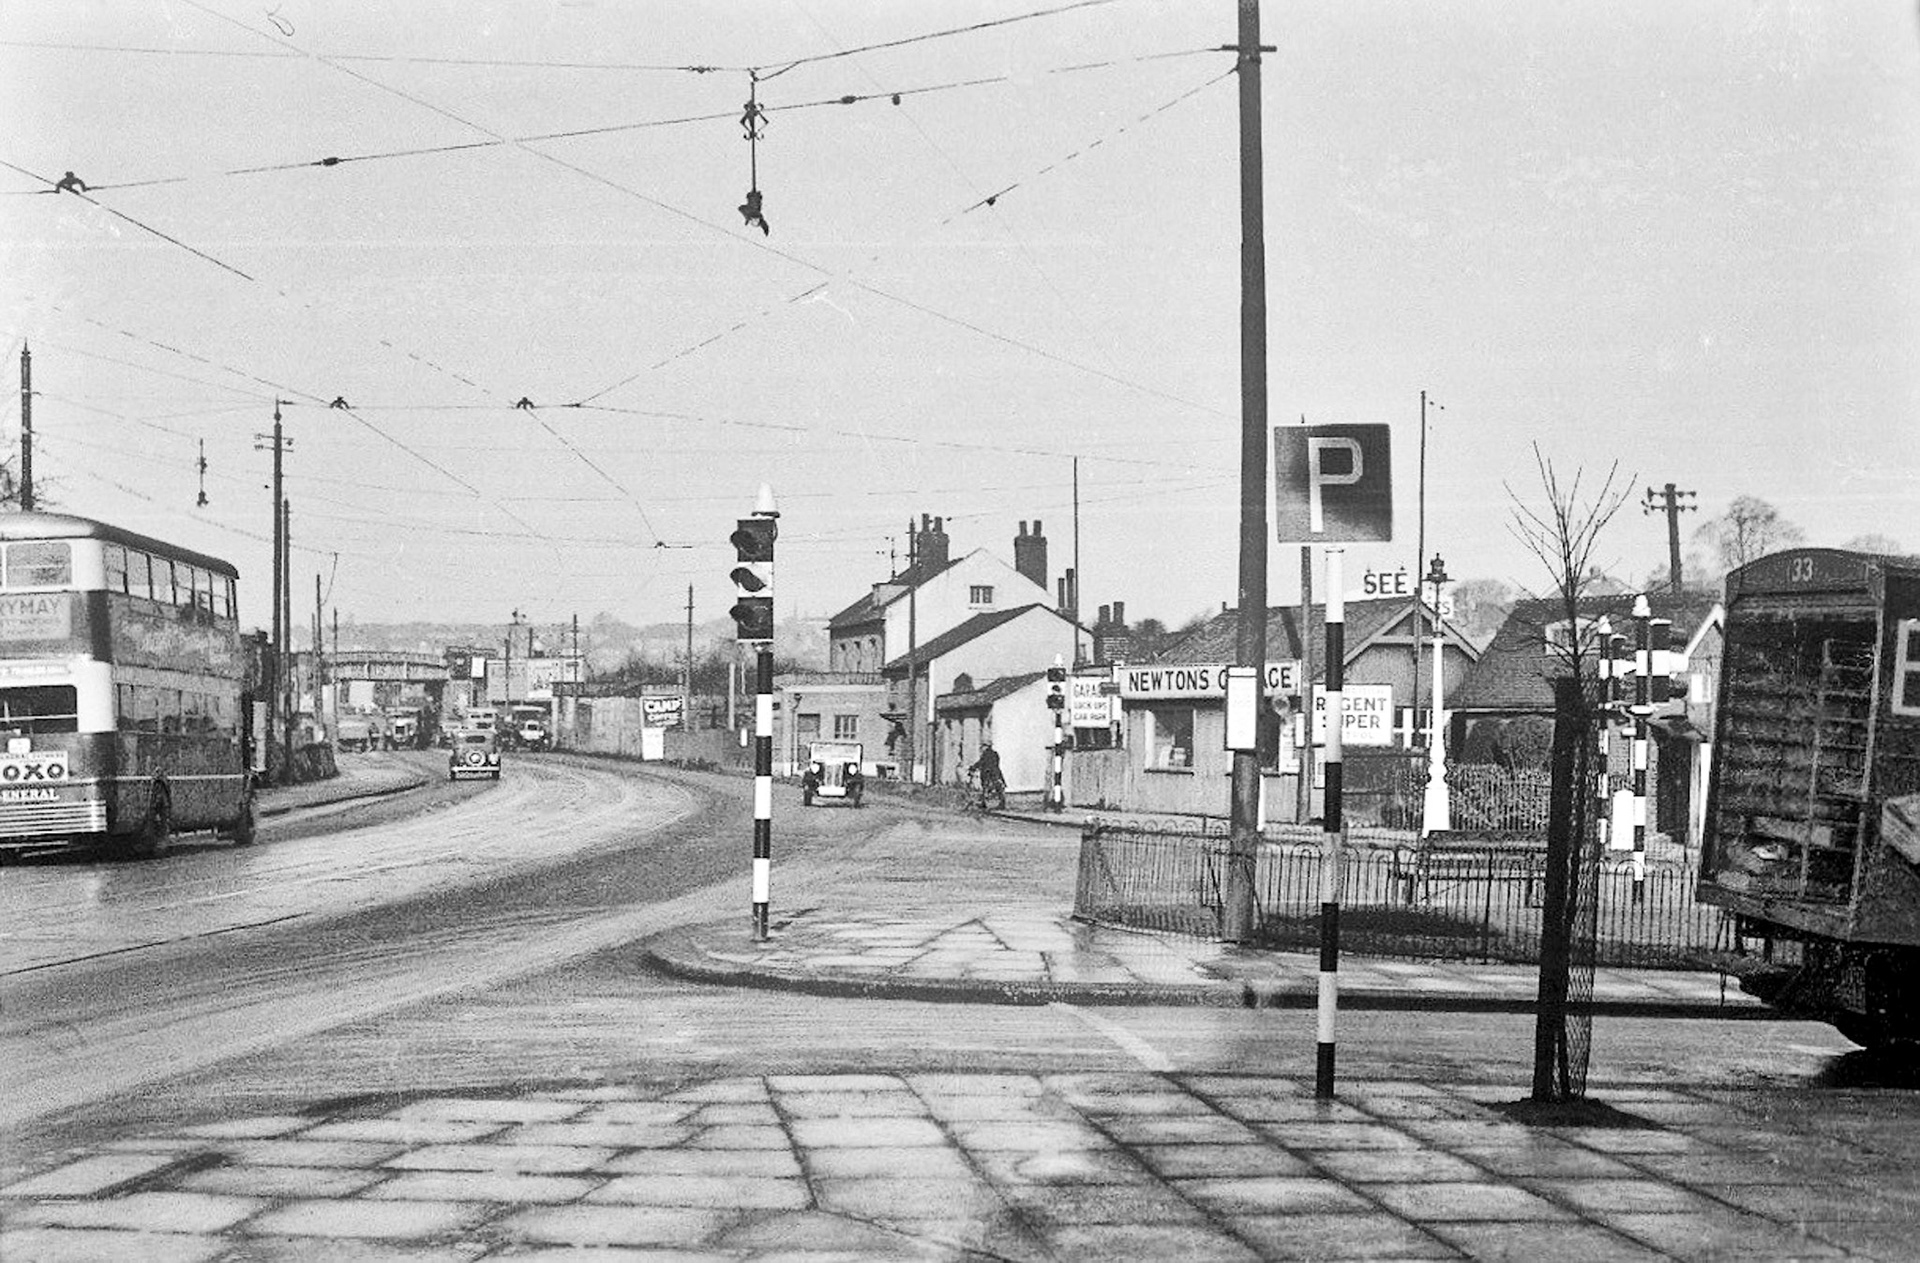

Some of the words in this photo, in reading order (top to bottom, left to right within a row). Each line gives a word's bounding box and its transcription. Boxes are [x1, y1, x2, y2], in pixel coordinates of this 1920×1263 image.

[1308, 437, 1363, 532] P
[1791, 557, 1814, 582] 33
[1364, 573, 1408, 594] SEE
[1129, 669, 1210, 692] NEWTONS
[1316, 697, 1387, 712] RGENT
[3, 763, 65, 781] OXO
[0, 787, 60, 803] ENERAL
